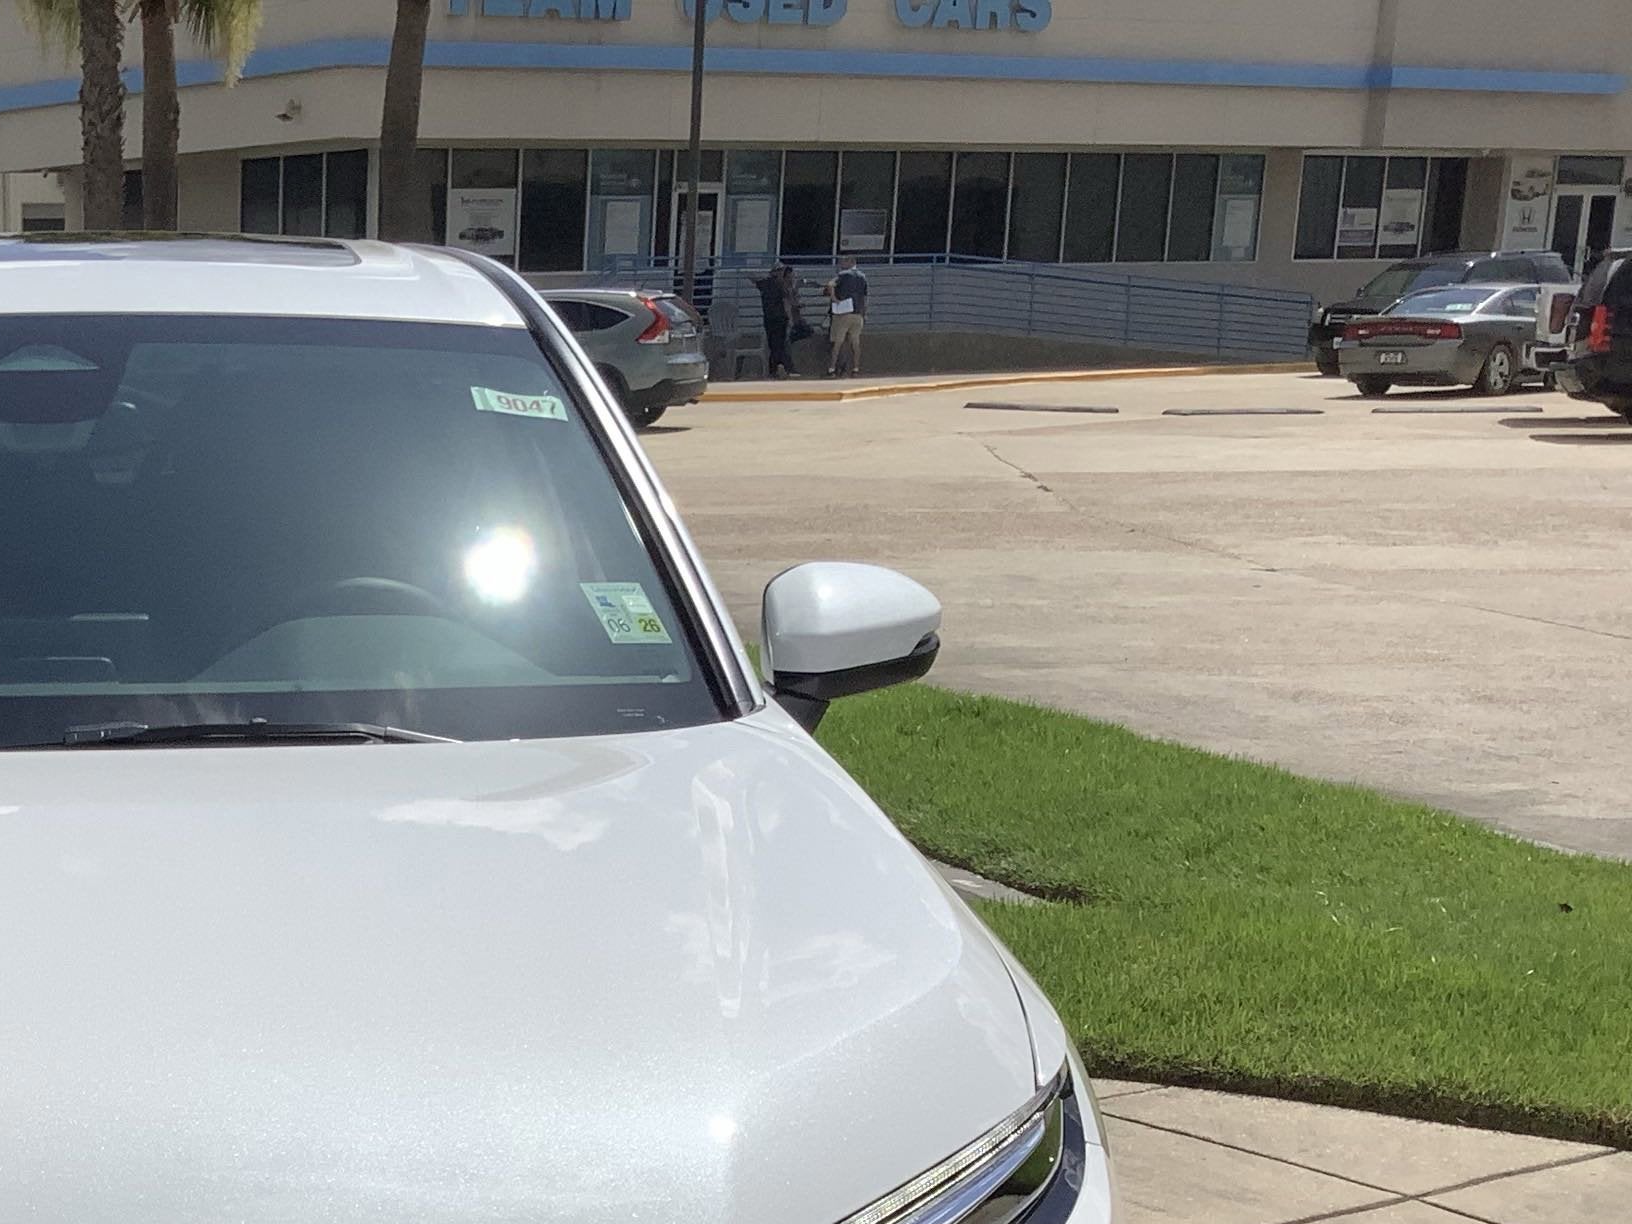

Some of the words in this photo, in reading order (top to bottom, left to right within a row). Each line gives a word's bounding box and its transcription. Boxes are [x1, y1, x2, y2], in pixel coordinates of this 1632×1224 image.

[895, 0, 1052, 32] CARS
[496, 395, 556, 415] 9047
[608, 618, 631, 633] 06
[638, 618, 661, 633] 26
